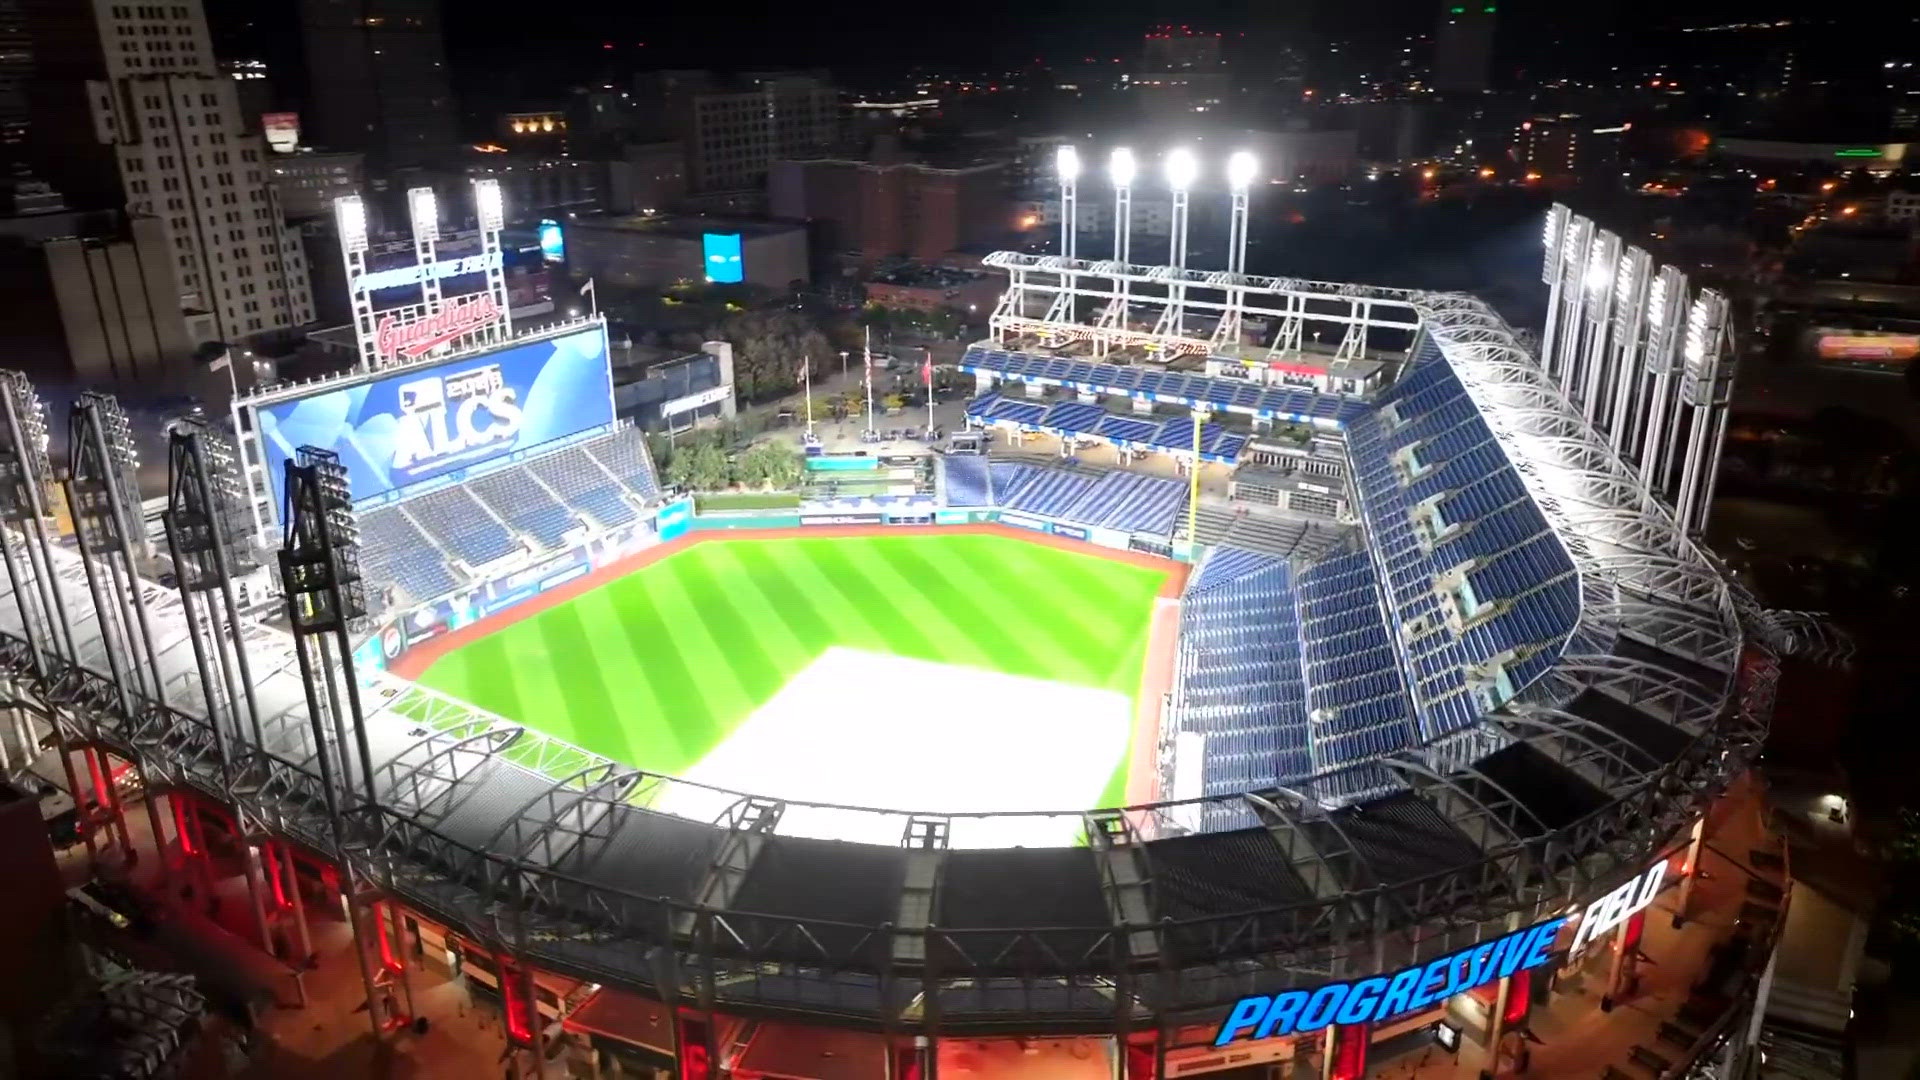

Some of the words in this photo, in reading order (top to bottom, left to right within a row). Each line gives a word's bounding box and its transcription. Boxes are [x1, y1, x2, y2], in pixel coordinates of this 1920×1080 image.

[377, 294, 501, 364] Guardians
[392, 387, 522, 470] ALCS
[1214, 916, 1567, 1047] PROGRESSIVE
[1569, 858, 1669, 953] FIELD
